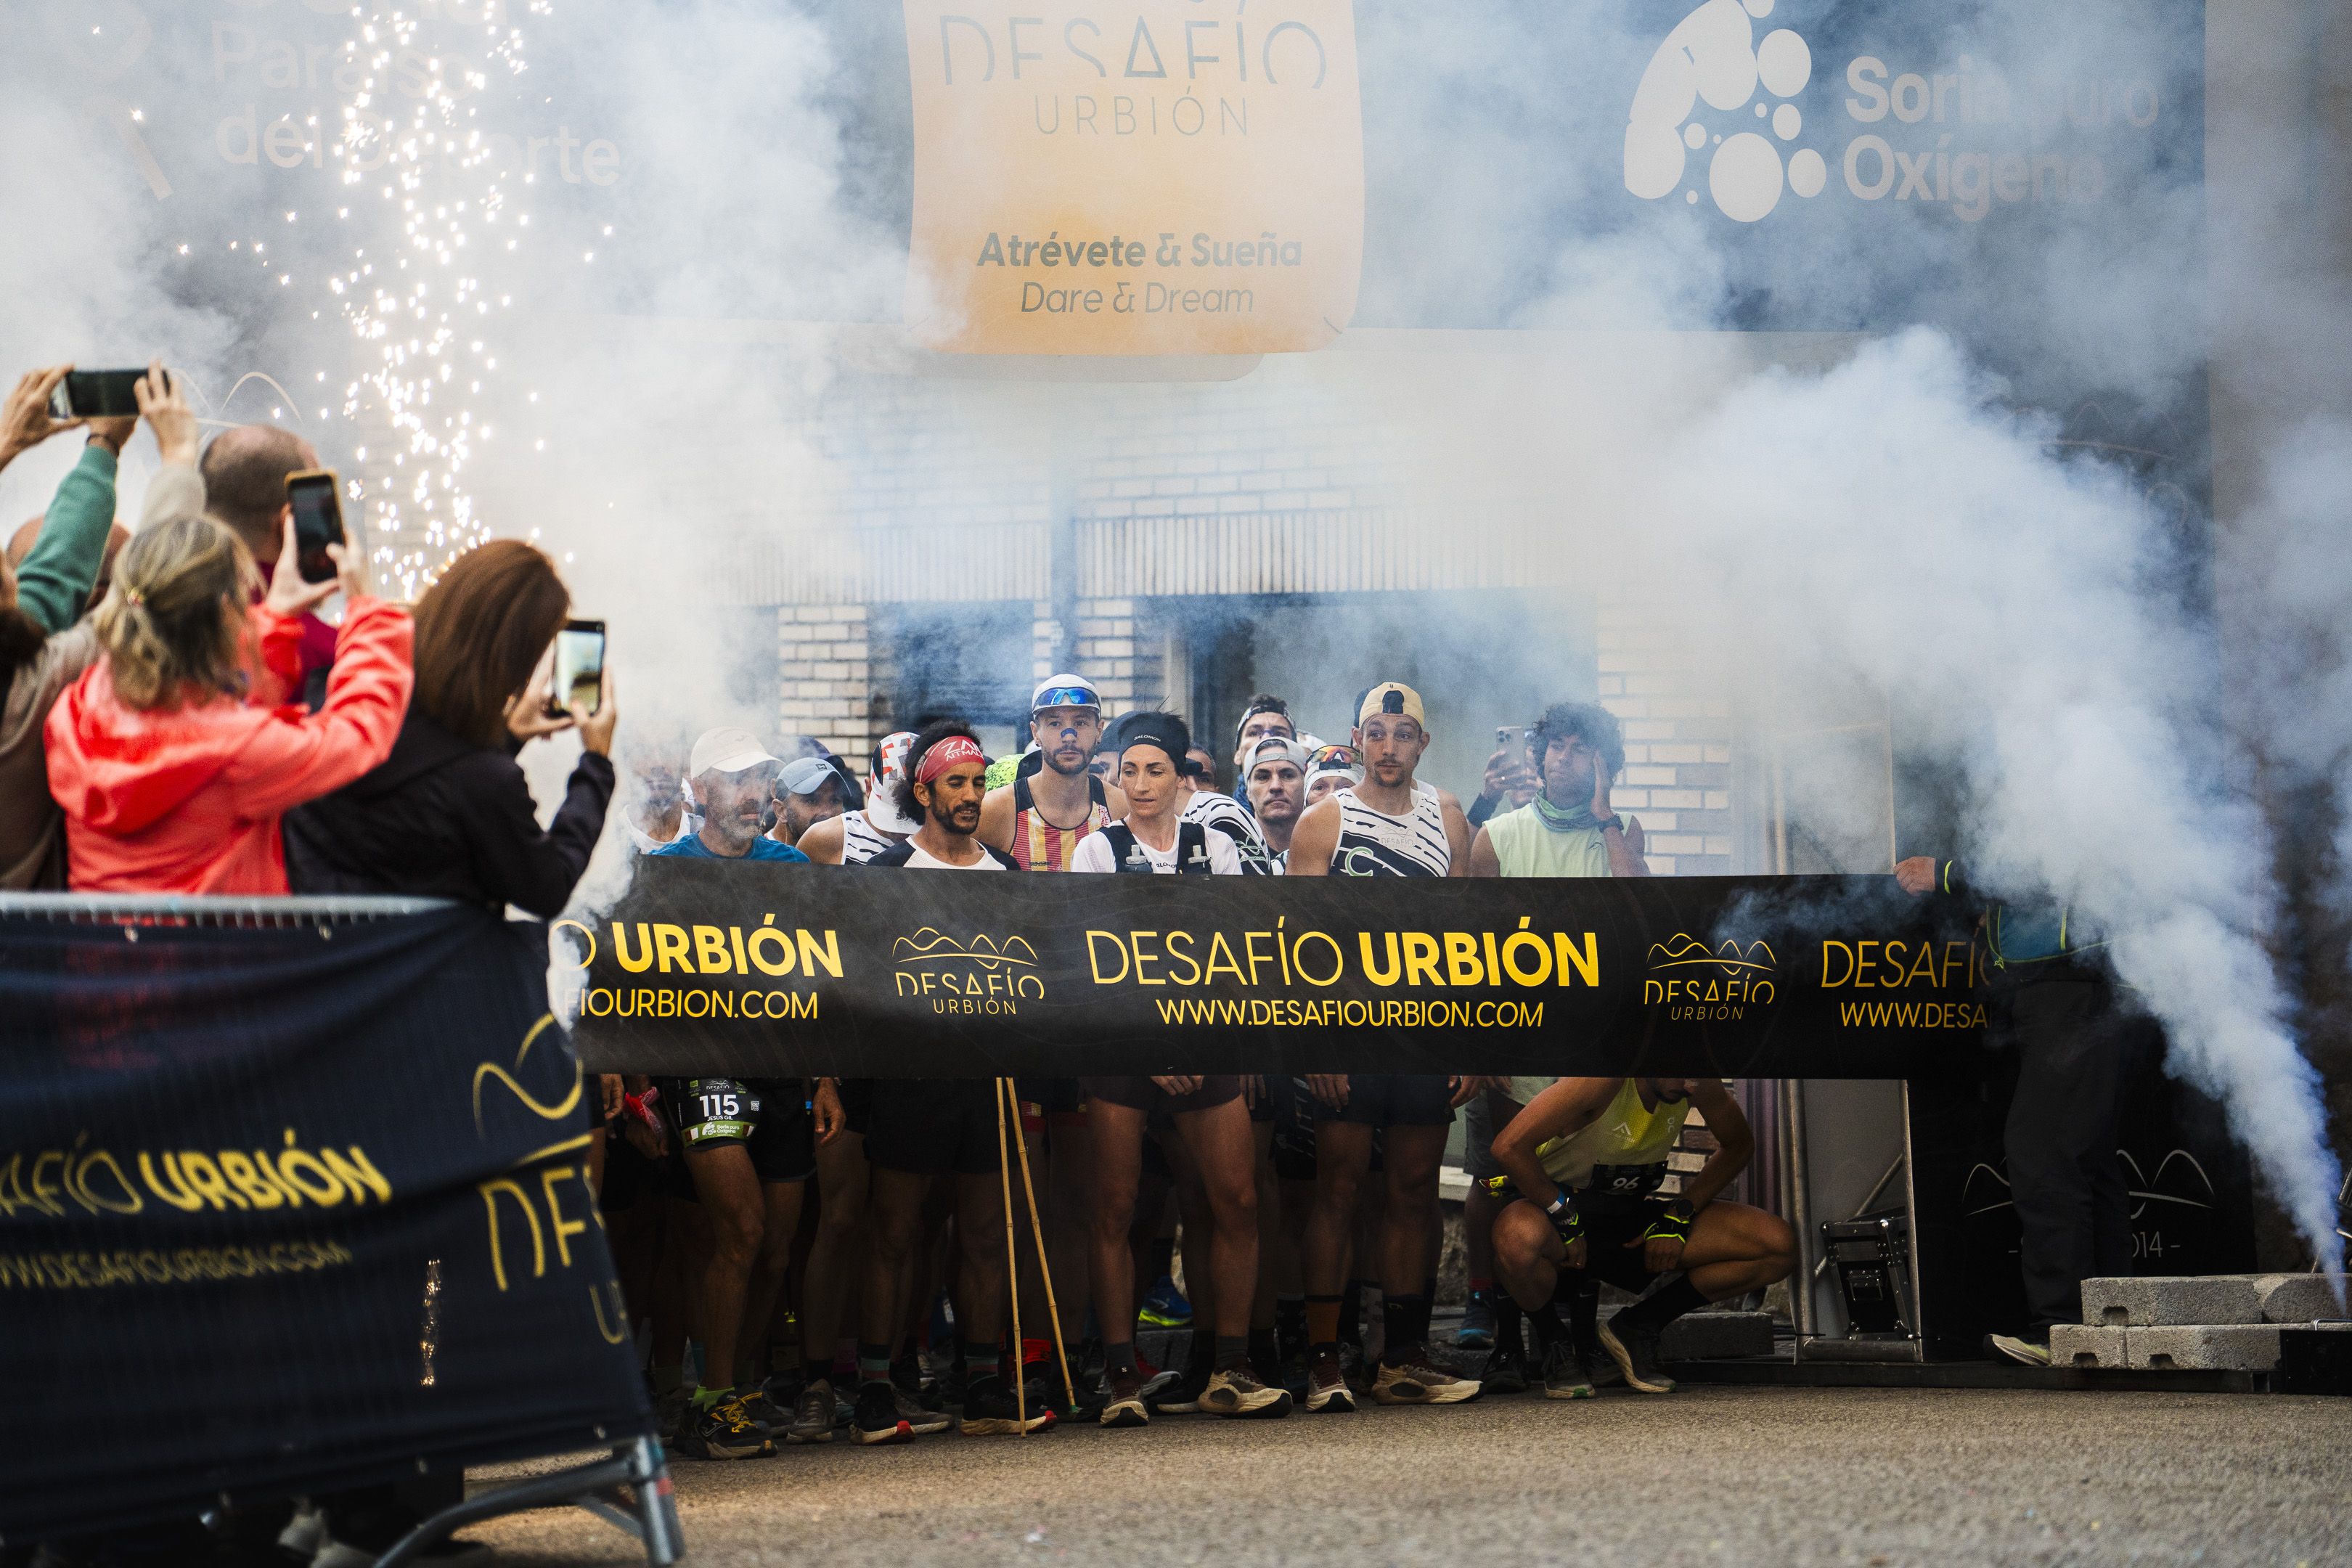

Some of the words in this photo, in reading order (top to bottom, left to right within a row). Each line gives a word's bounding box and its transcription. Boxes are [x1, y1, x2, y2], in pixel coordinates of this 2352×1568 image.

[939, 0, 1327, 89] DESAFÍO
[1034, 85, 1249, 136] URBIÓN
[215, 103, 323, 168] del
[343, 111, 621, 192] Deporte
[1844, 133, 2106, 222] Oxígeno
[977, 231, 1146, 268] Atrévete
[1156, 234, 1181, 268] &
[1191, 230, 1302, 268] Sueña
[1021, 281, 1103, 313] Dare
[1113, 282, 1135, 313] &
[1145, 281, 1254, 313] Dream
[612, 913, 844, 977] URBIÓN
[1086, 916, 1344, 987] DESAFÍO
[1357, 916, 1599, 987] URBIÓN
[894, 968, 1045, 1000] DESAFÍO
[1643, 973, 1776, 1005] DESAFÍO
[933, 996, 1017, 1016] URBIÓN
[1156, 999, 1544, 1027] WWW.DESAFIOURBION.COM
[1670, 1003, 1744, 1021] URBIÓN
[1841, 1003, 1992, 1029] WWW.DESA
[699, 1094, 740, 1117] 115
[137, 1126, 393, 1212] URBIÓN
[1612, 1176, 1641, 1190] 96
